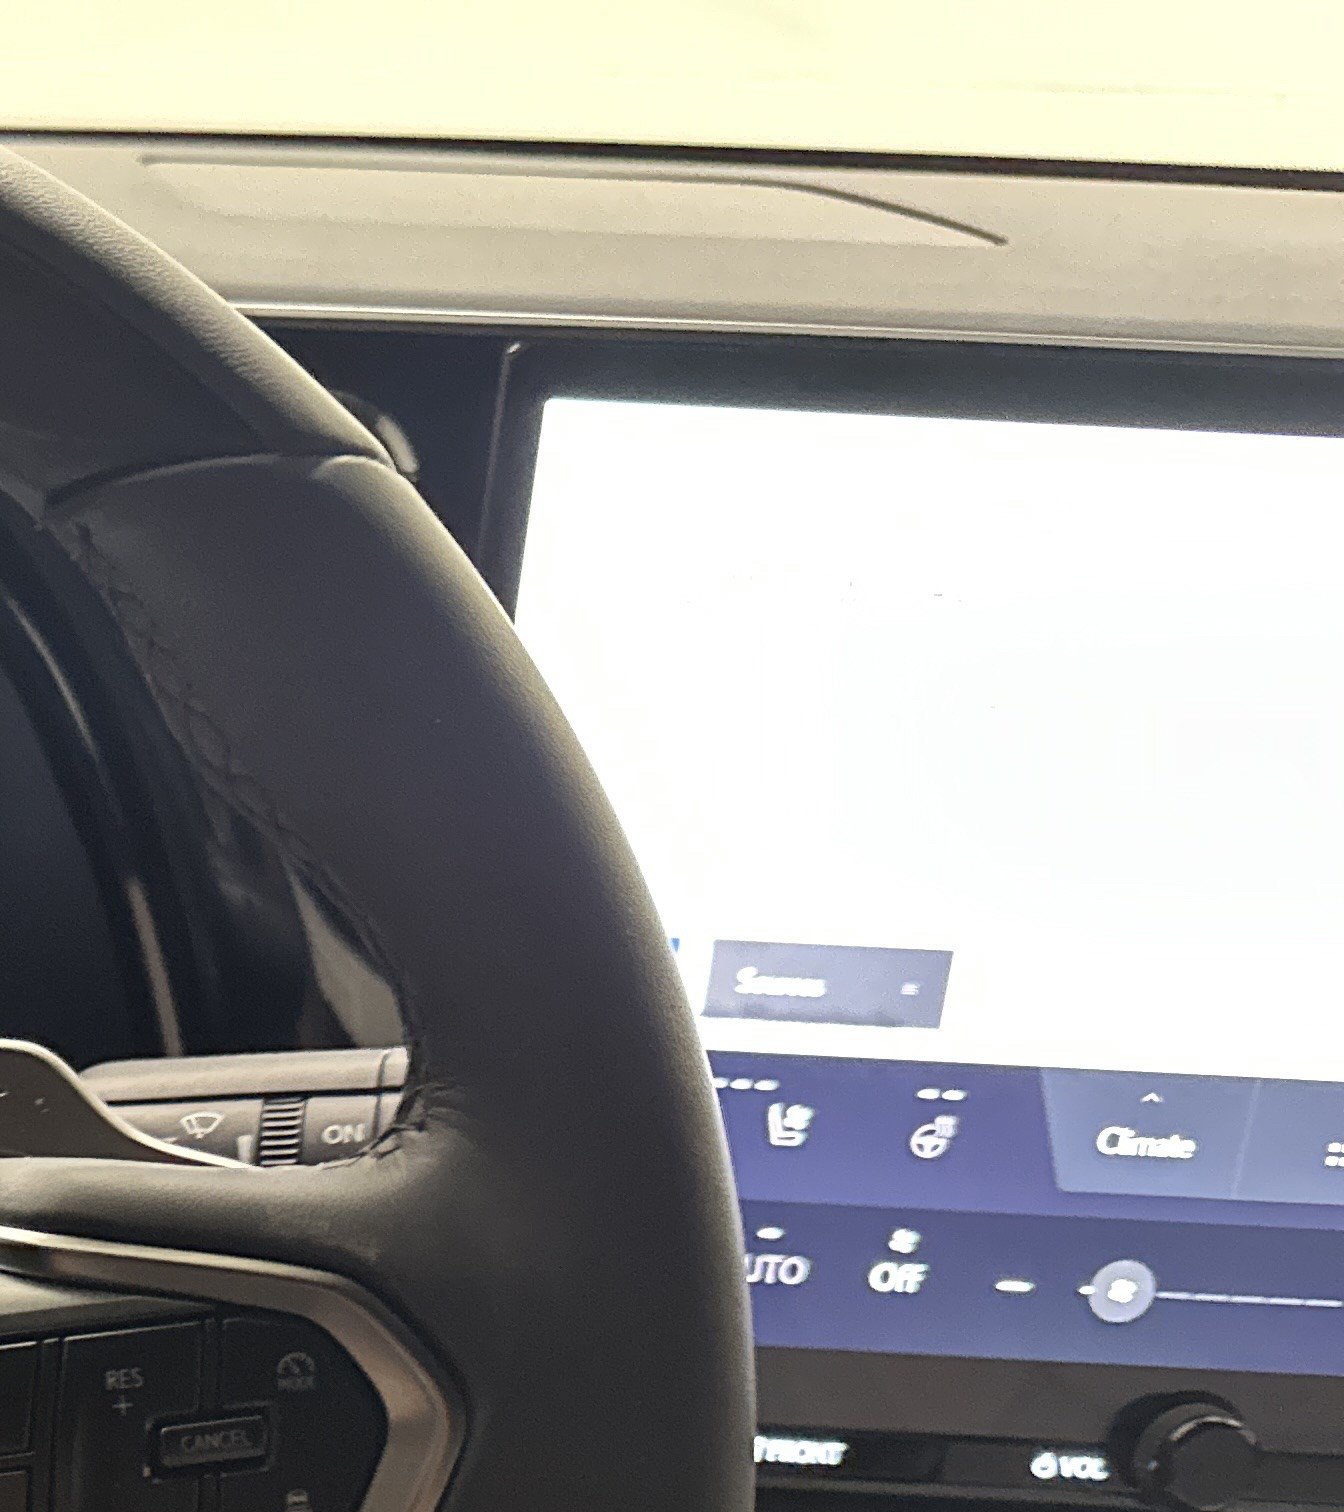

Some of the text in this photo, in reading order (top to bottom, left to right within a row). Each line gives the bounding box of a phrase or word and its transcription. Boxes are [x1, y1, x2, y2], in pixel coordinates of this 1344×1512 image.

[321, 1121, 367, 1146] ON
[1096, 1126, 1199, 1163] Climate
[745, 1254, 810, 1286] UTO
[105, 1366, 145, 1391] RES
[179, 1431, 252, 1456] CANCEL
